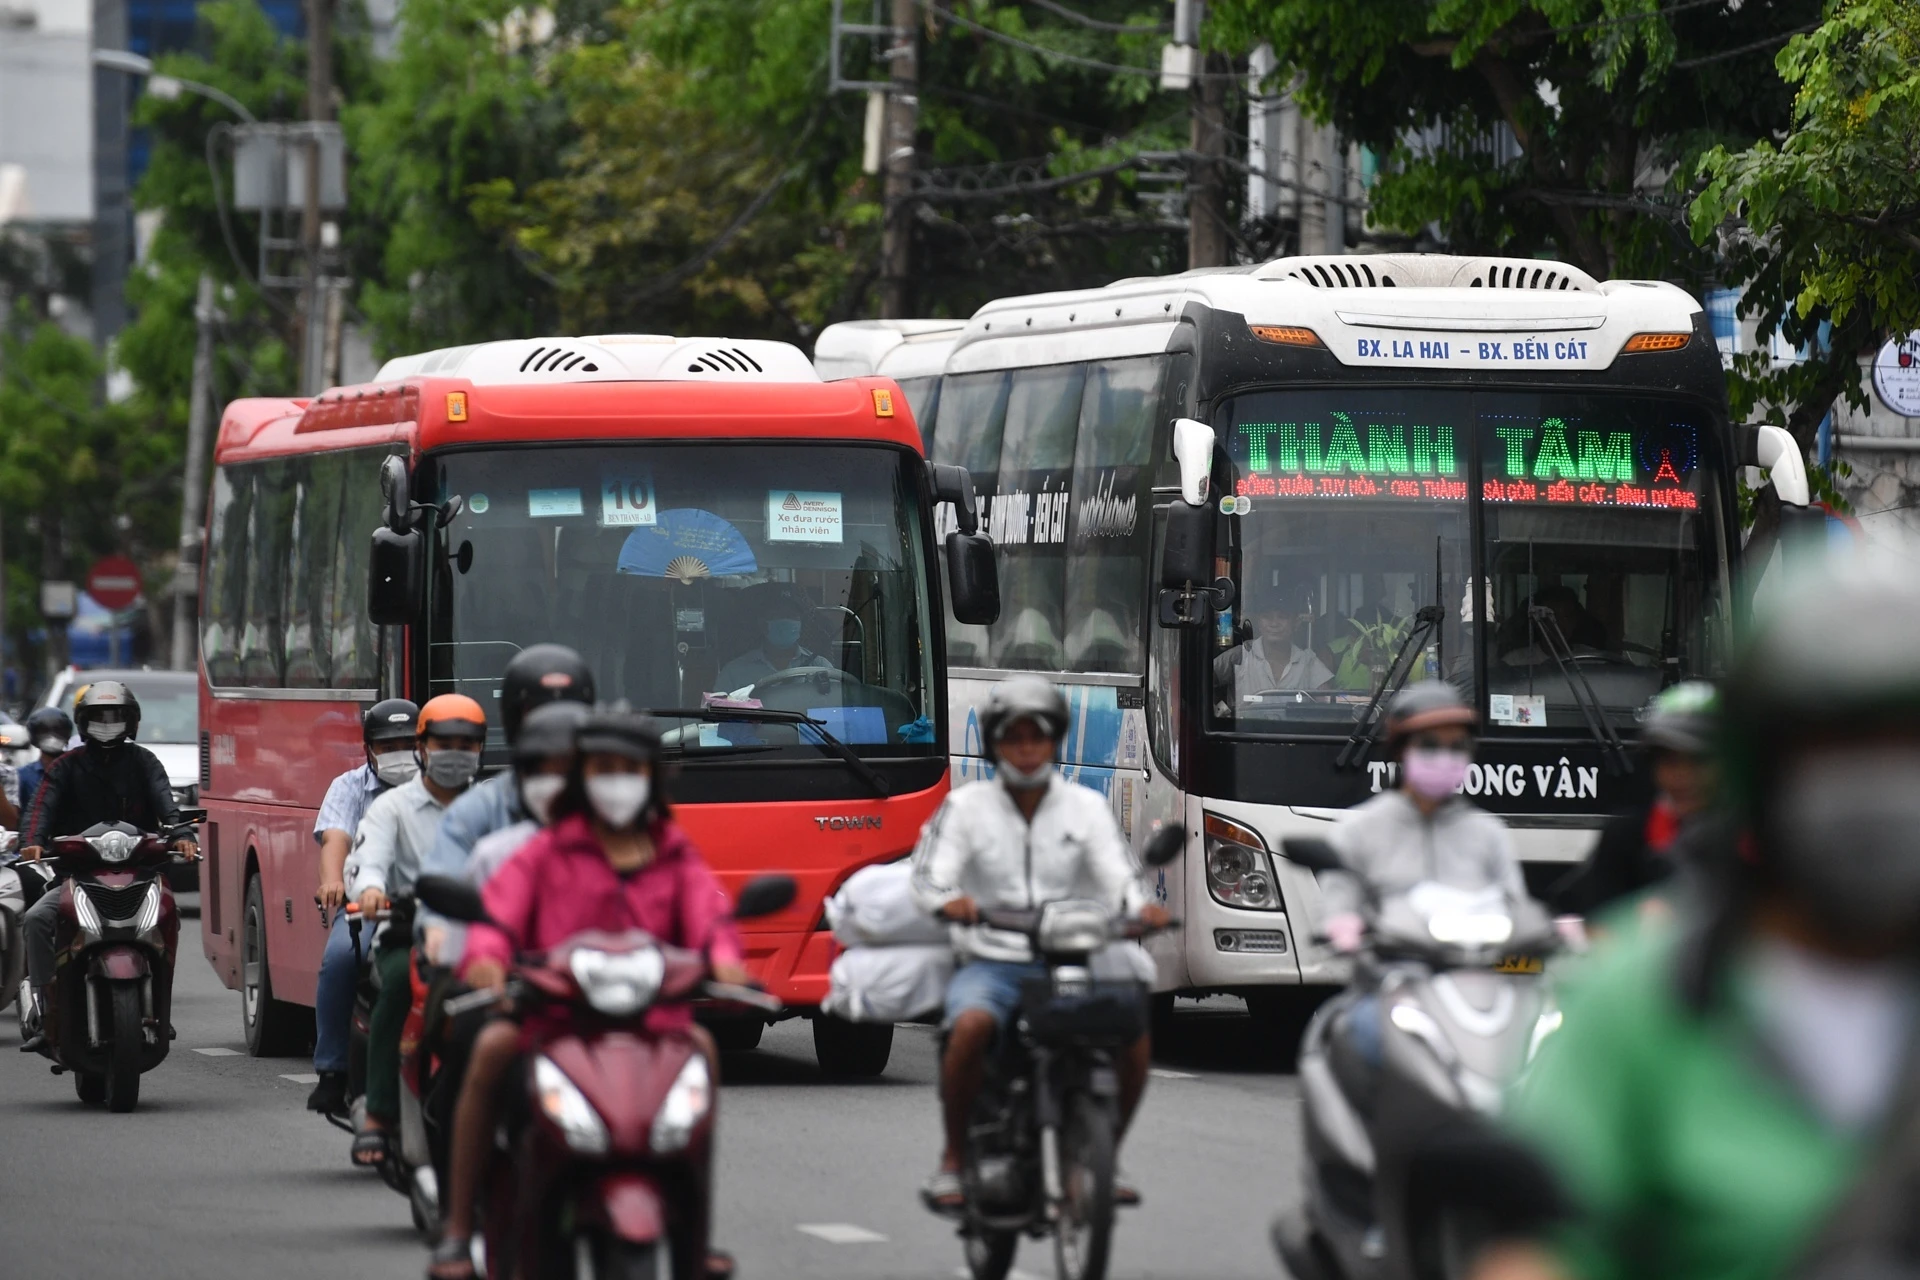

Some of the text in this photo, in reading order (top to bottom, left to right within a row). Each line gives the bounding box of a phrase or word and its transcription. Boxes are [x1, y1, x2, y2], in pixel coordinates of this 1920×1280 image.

[1358, 339, 1388, 358] BX.
[1393, 340, 1414, 359] LA
[1419, 341, 1449, 360] HAI
[1479, 342, 1508, 360] BX.
[1513, 335, 1549, 361] BẾN
[1555, 337, 1588, 361] CÁT
[1238, 411, 1633, 481] THÀNH TÂM
[608, 480, 649, 510] 10
[1236, 472, 1276, 496] ĐỒNG
[1278, 474, 1313, 495] XUÂN
[1422, 477, 1467, 498] THÀNH
[1483, 478, 1505, 499] SÀI
[1506, 479, 1536, 501] GÒN
[1548, 479, 1575, 502] BẾN
[1615, 483, 1647, 504] BÌNH
[777, 513, 840, 524] Xe đưa rước
[1034, 475, 1053, 544] BẾN
[1050, 481, 1069, 544] CÁT
[782, 525, 830, 535] nhân viên
[1532, 756, 1599, 799] VÂN
[814, 815, 882, 831] TOWN
